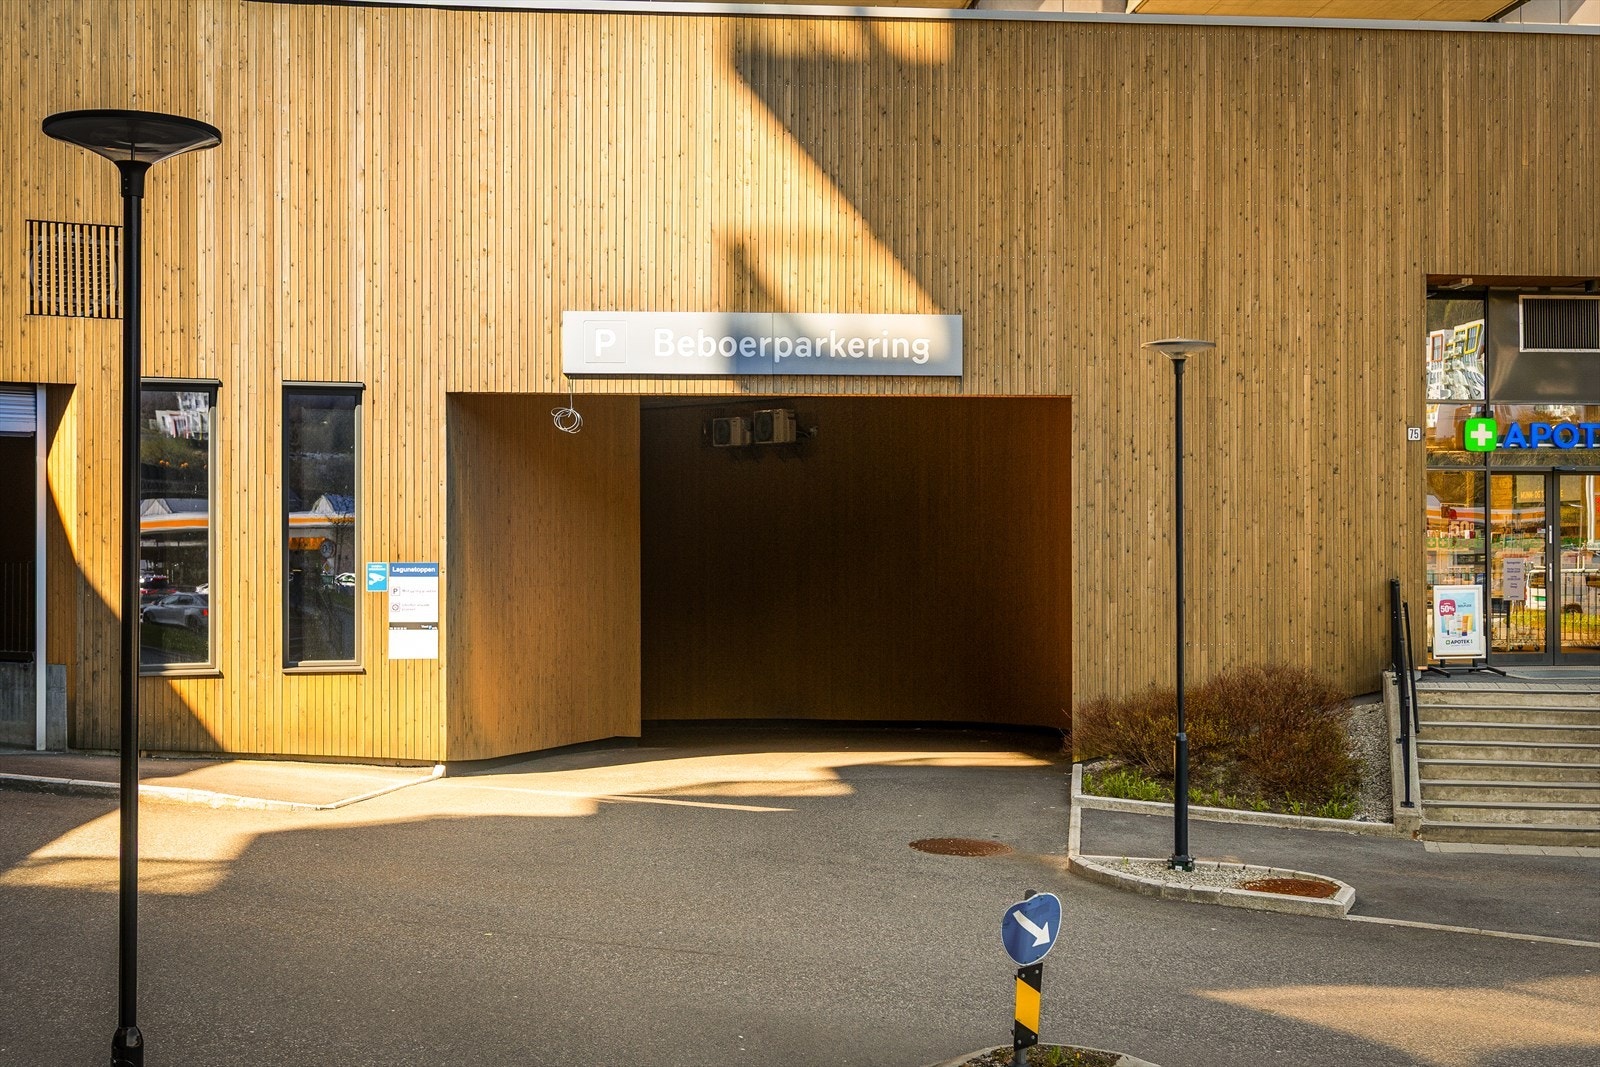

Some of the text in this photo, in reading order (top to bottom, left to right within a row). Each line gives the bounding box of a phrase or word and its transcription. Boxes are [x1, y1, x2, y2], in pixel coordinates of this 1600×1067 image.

[594, 328, 931, 365] P Beboerparkering
[1409, 428, 1419, 440] 75
[1503, 421, 1600, 449] APOT
[392, 566, 436, 574] Lagunetoppen
[1440, 604, 1455, 613] 50%
